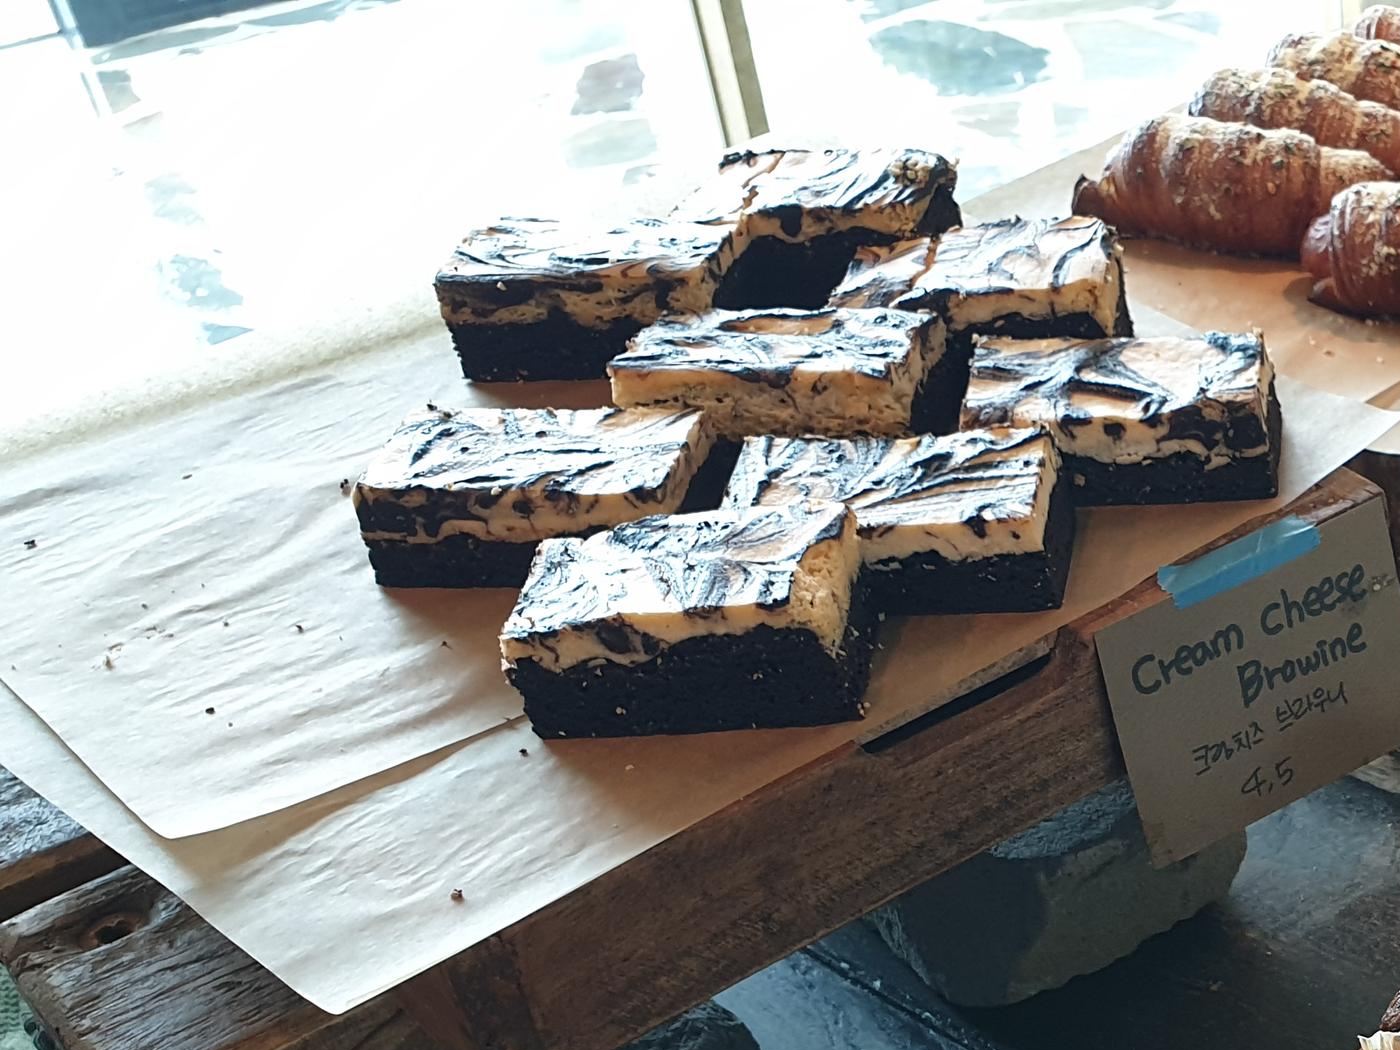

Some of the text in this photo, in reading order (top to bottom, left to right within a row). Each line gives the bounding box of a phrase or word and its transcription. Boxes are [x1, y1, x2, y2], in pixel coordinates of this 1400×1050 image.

[1131, 623, 1244, 695] Cream
[1236, 622, 1367, 708] Browine
[1275, 681, 1348, 731] 브라우니
